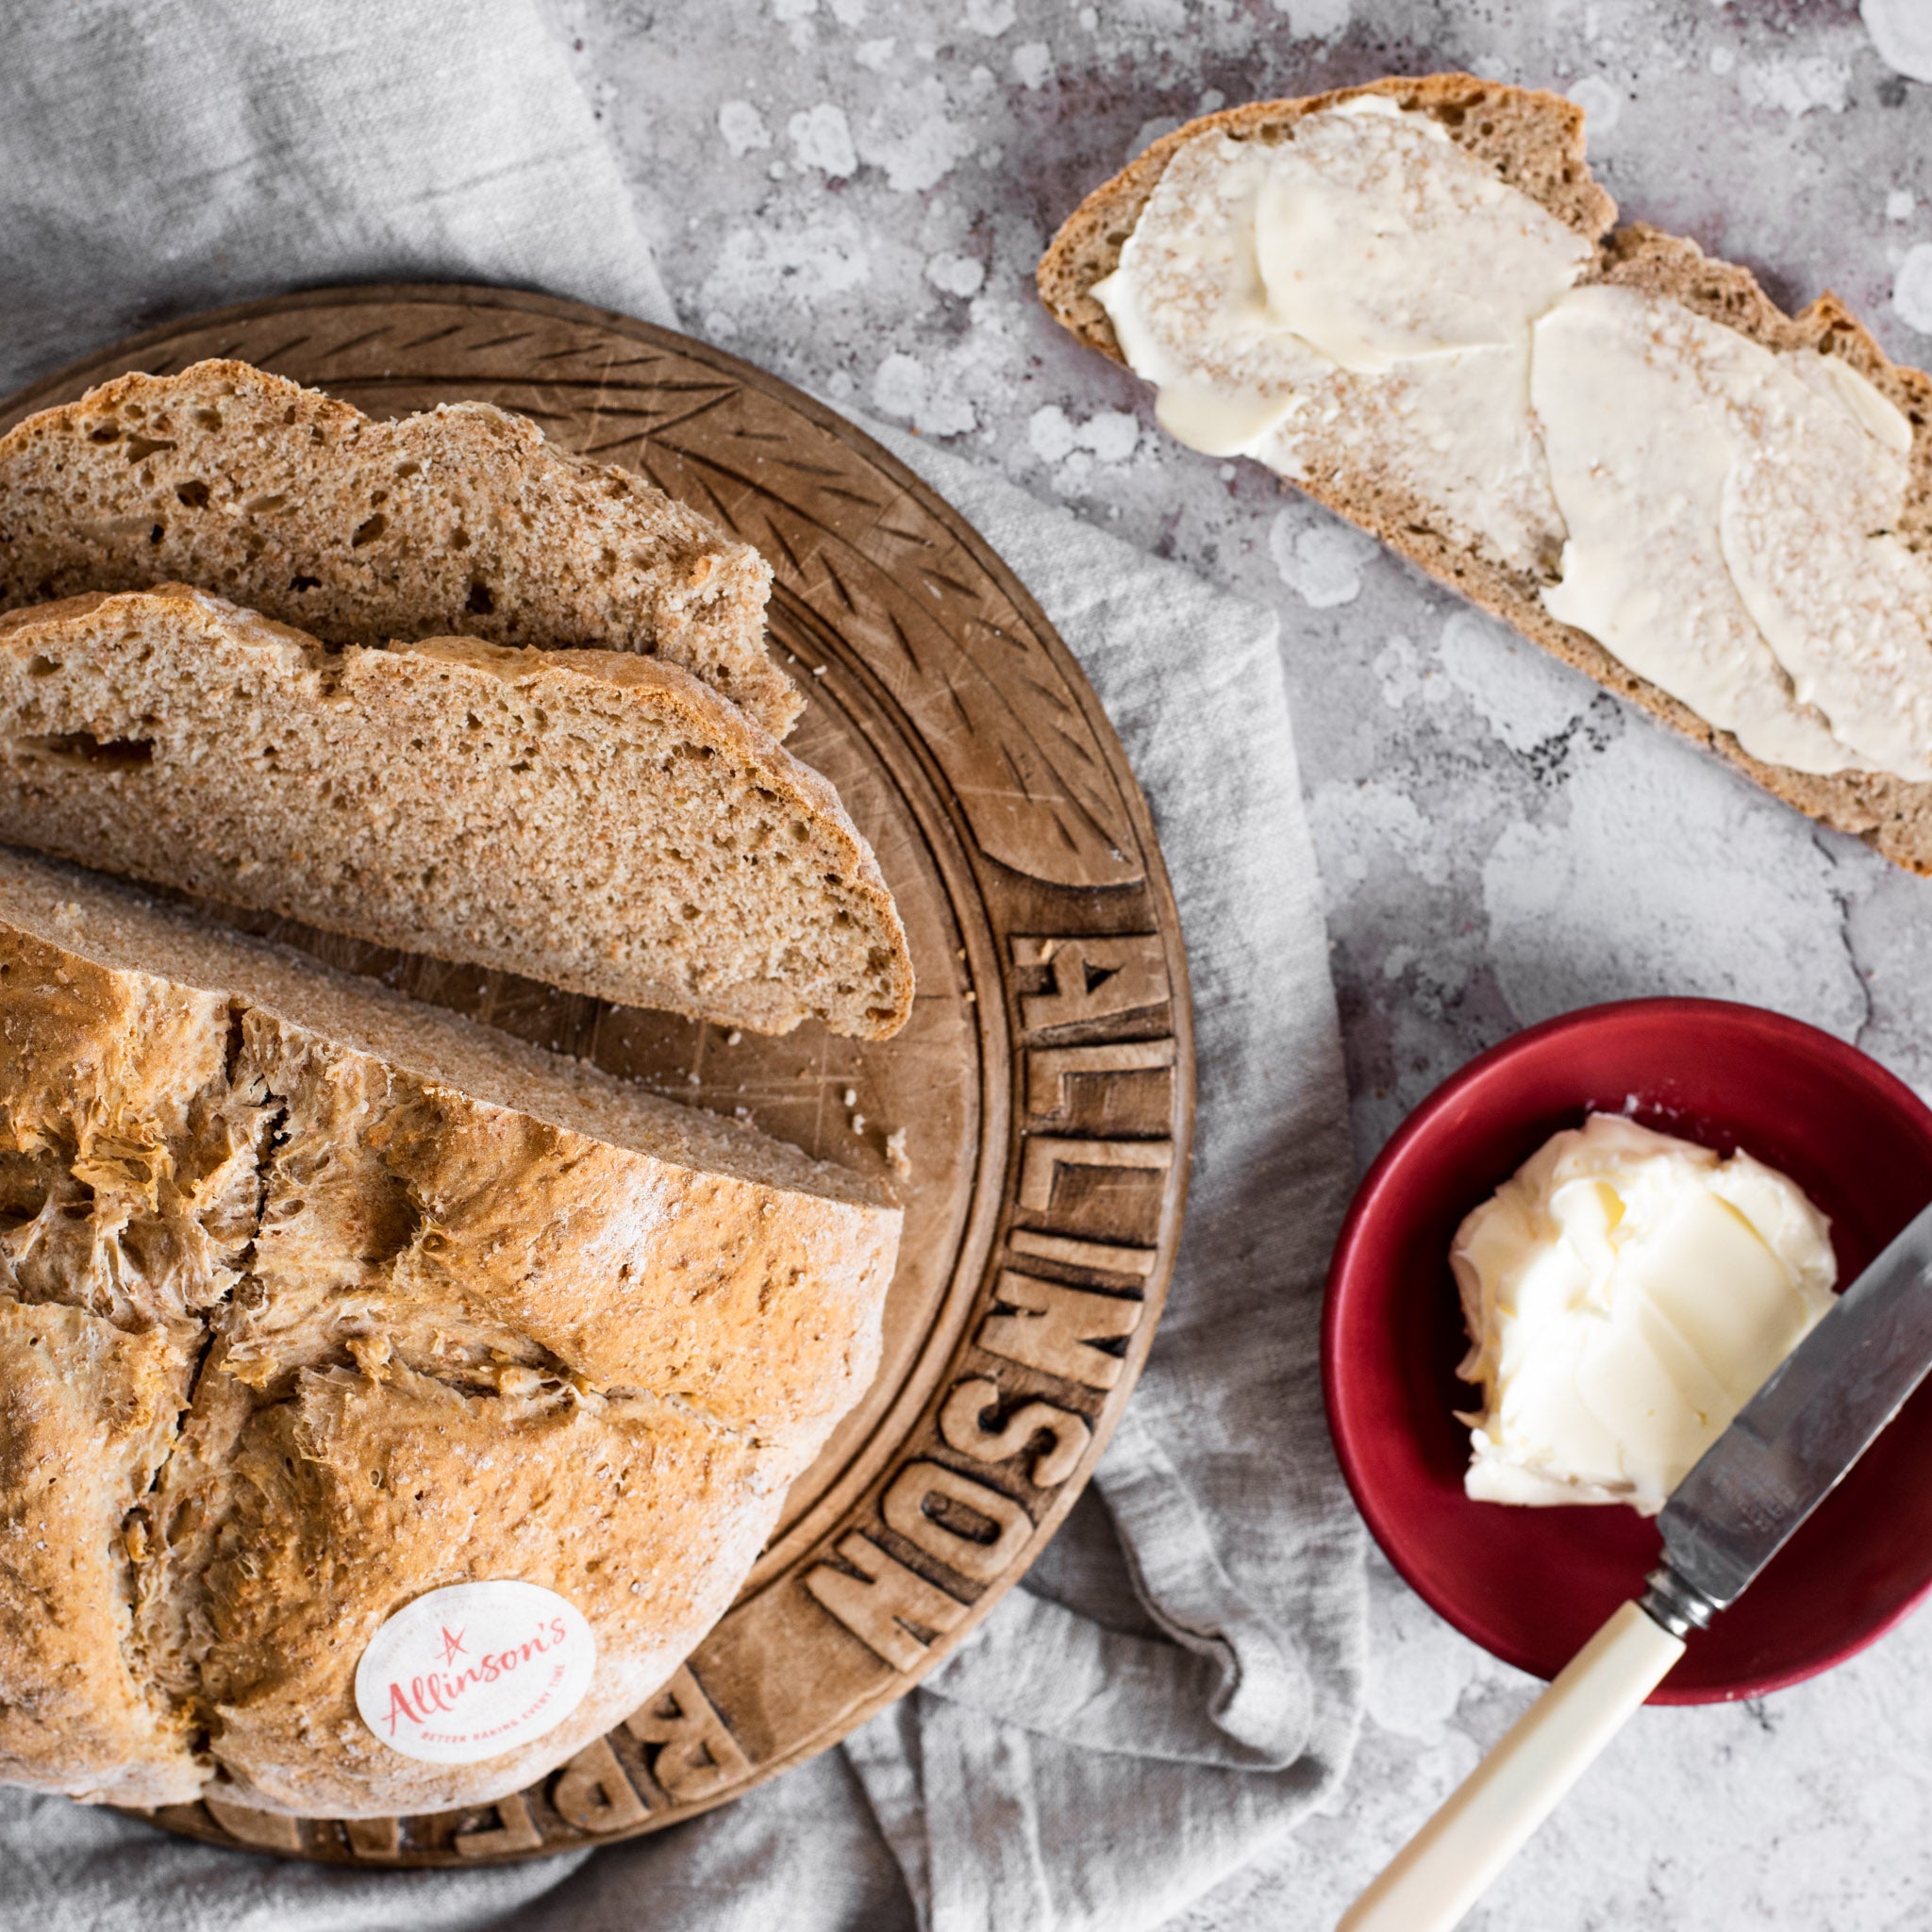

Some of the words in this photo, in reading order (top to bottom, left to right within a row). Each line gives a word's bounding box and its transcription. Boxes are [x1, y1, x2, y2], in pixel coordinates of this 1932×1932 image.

[805, 933, 1175, 1673] ALLINSON
[380, 1617, 566, 1737] Allinson's
[421, 1731, 467, 1743] BETTER
[473, 1720, 519, 1740] BAKING
[522, 1692, 552, 1720] EVERY
[549, 1664, 566, 1687] TIME
